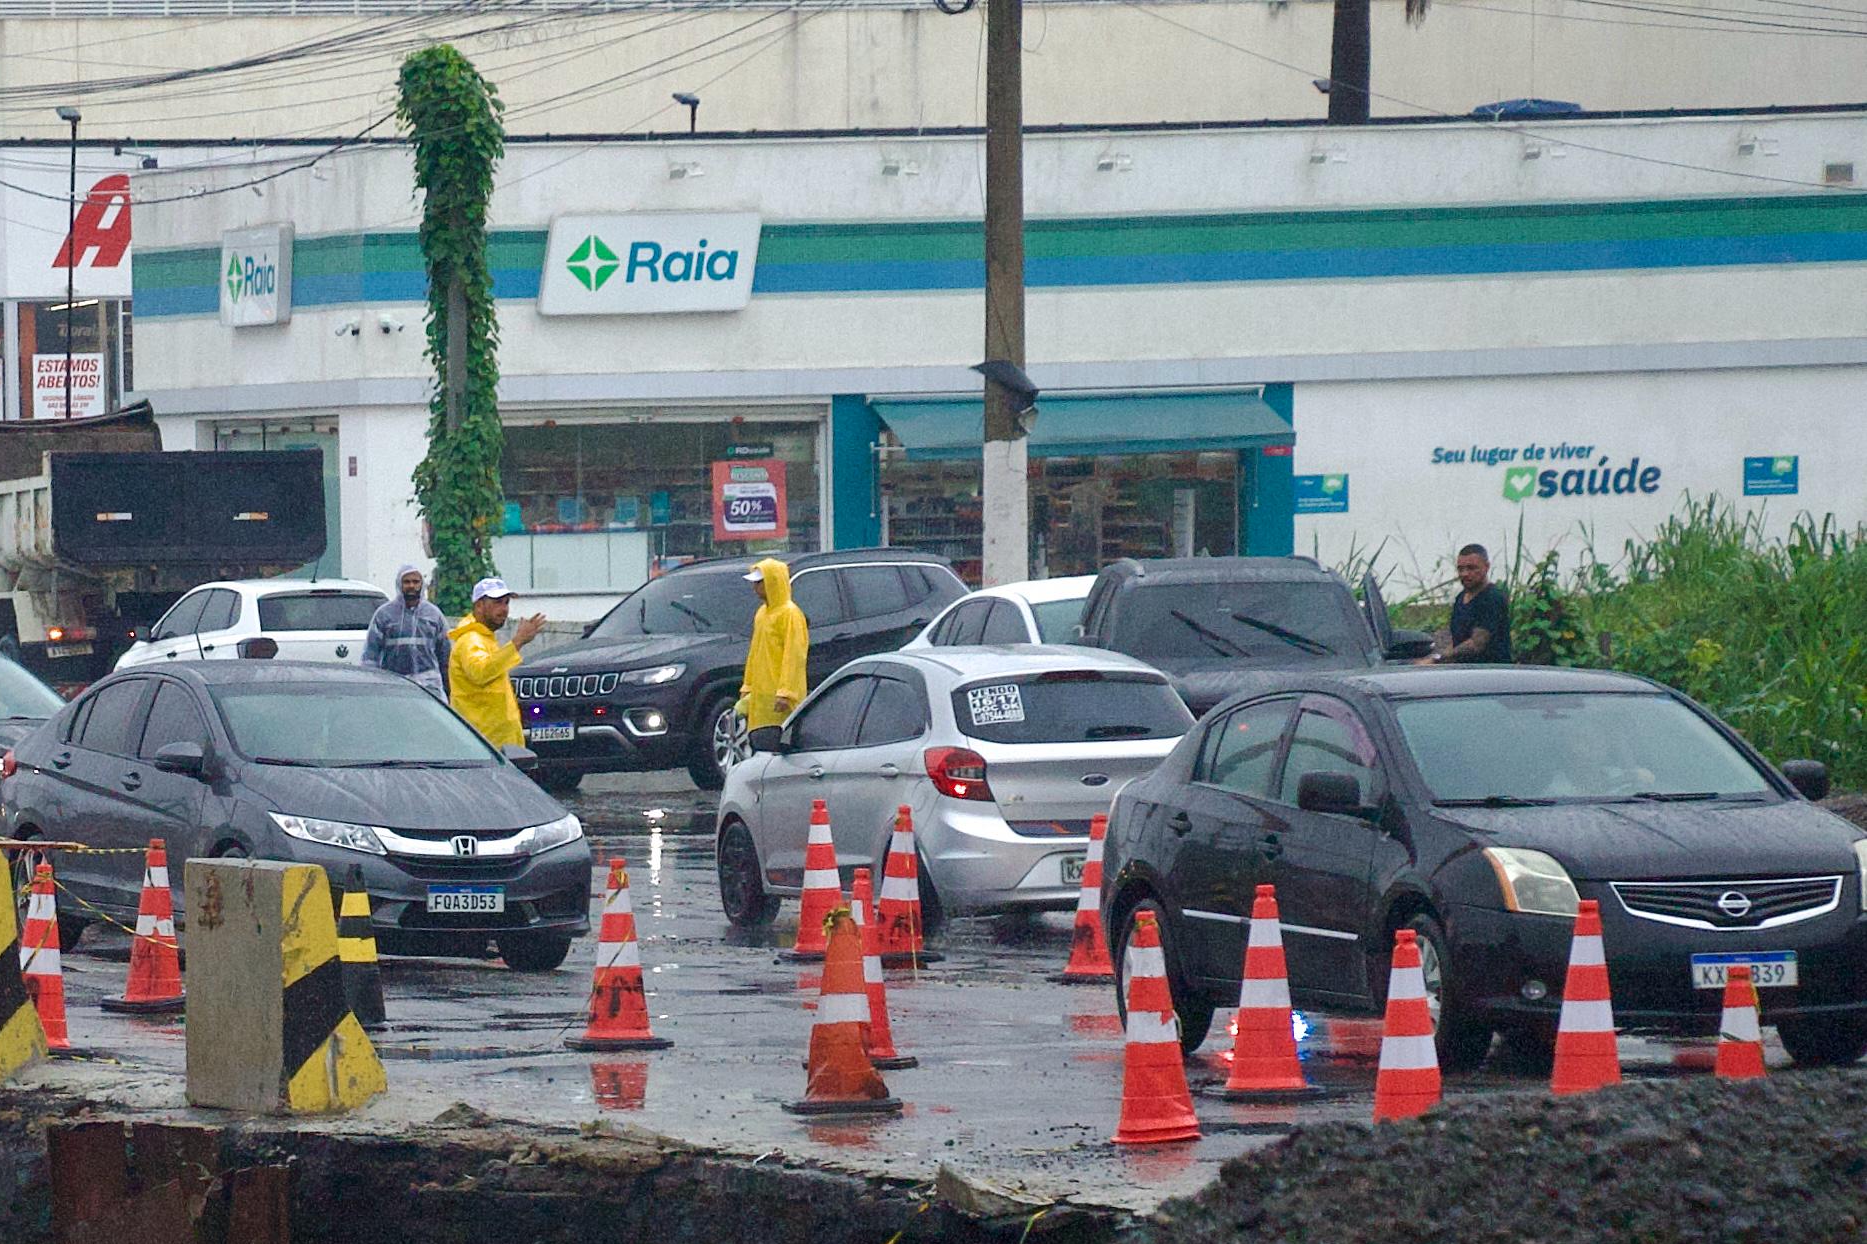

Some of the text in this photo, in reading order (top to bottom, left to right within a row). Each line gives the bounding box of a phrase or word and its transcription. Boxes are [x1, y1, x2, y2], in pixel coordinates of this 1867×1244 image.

[628, 239, 738, 283] Raia
[244, 252, 275, 296] Raia
[37, 358, 98, 373] ESTAMOS
[1432, 441, 1596, 467] Seu lugar de viver
[1537, 455, 1662, 499] saúde
[730, 500, 763, 516] 50%
[970, 684, 1017, 698] VENDO
[434, 894, 497, 910] FQA3D53
